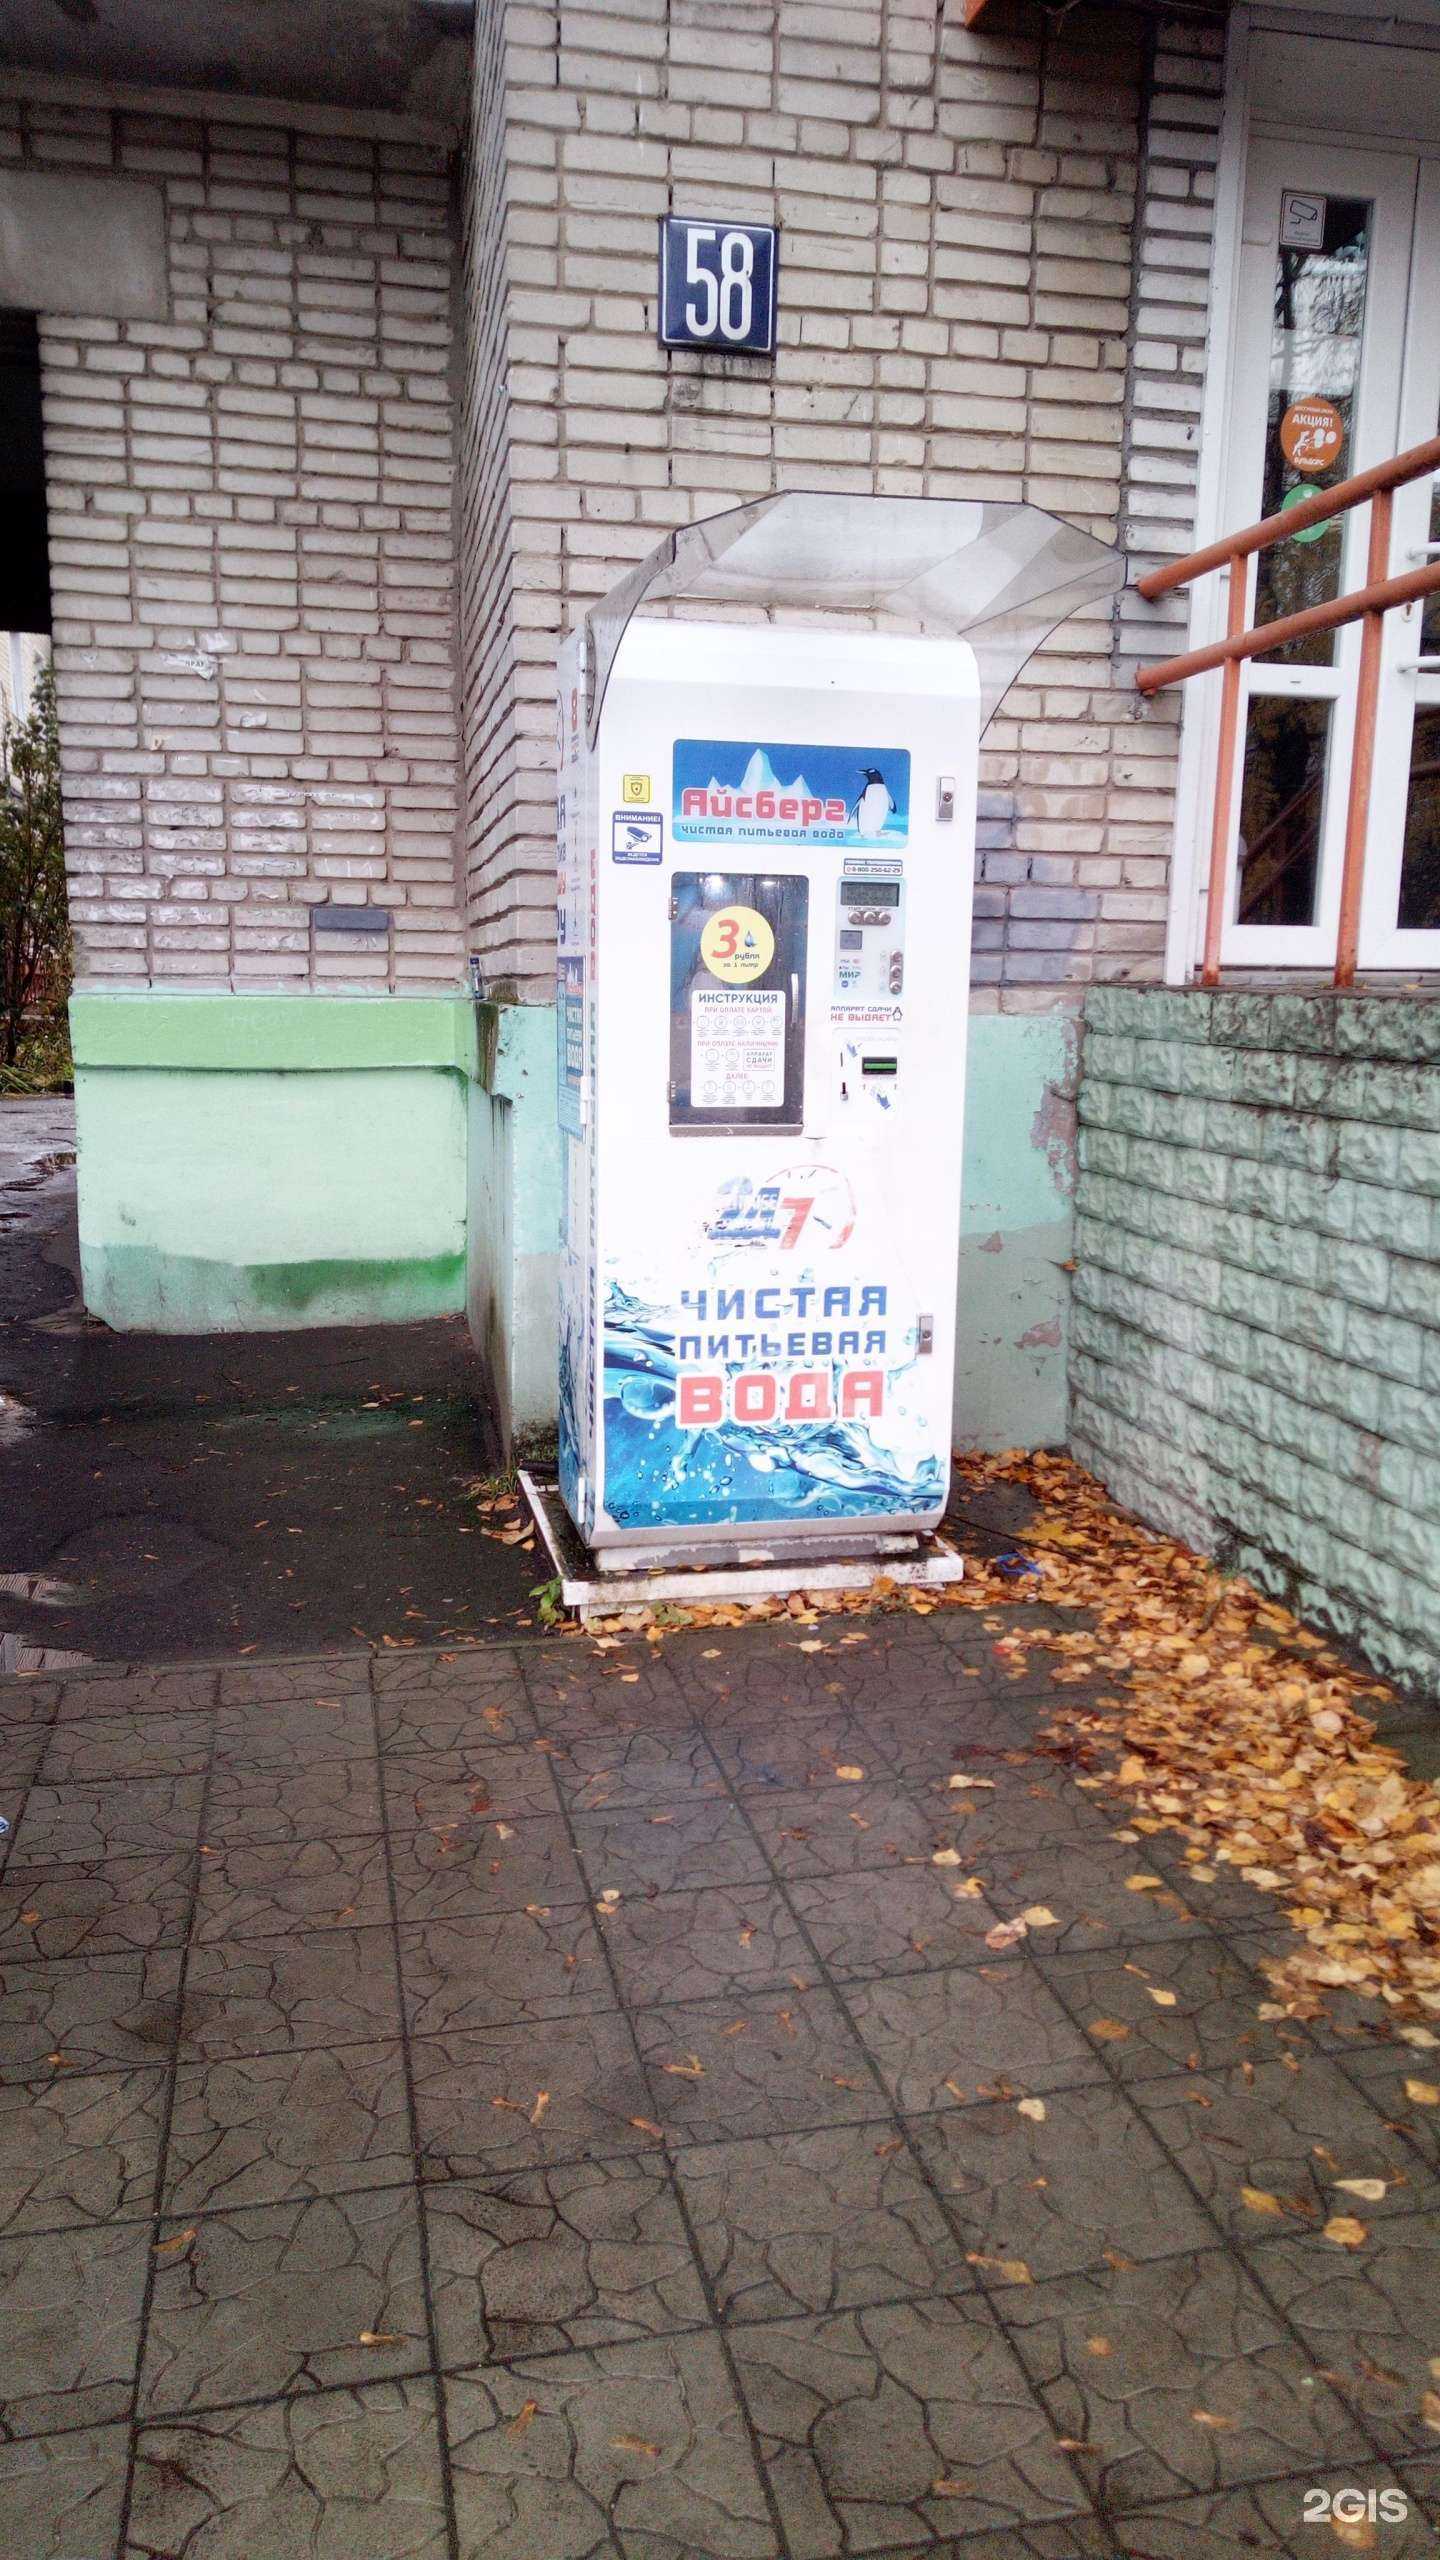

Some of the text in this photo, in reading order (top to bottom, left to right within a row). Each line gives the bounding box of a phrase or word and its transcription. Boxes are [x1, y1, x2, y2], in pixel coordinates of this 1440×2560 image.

[685, 228, 754, 341] 58
[1291, 414, 1333, 428] АКЦИЯ!
[683, 788, 845, 827] Айсберг
[615, 814, 661, 822] ВНИМАНИЕ!
[682, 825, 845, 839] чистая питьевая вода
[711, 918, 740, 959] 3
[699, 993, 778, 1005] ИНСТРУКЦИЯ
[704, 1006, 718, 1014] ПРИ
[720, 1006, 745, 1014] ОПЛАТЕ
[831, 1005, 865, 1013] АППАРАТ
[831, 1013, 844, 1021] НЕ
[681, 1286, 887, 1321] ЧИСТАЯ
[679, 1330, 886, 1360] ПИТЬЕВАЯ
[679, 1370, 884, 1425] ВОДА
